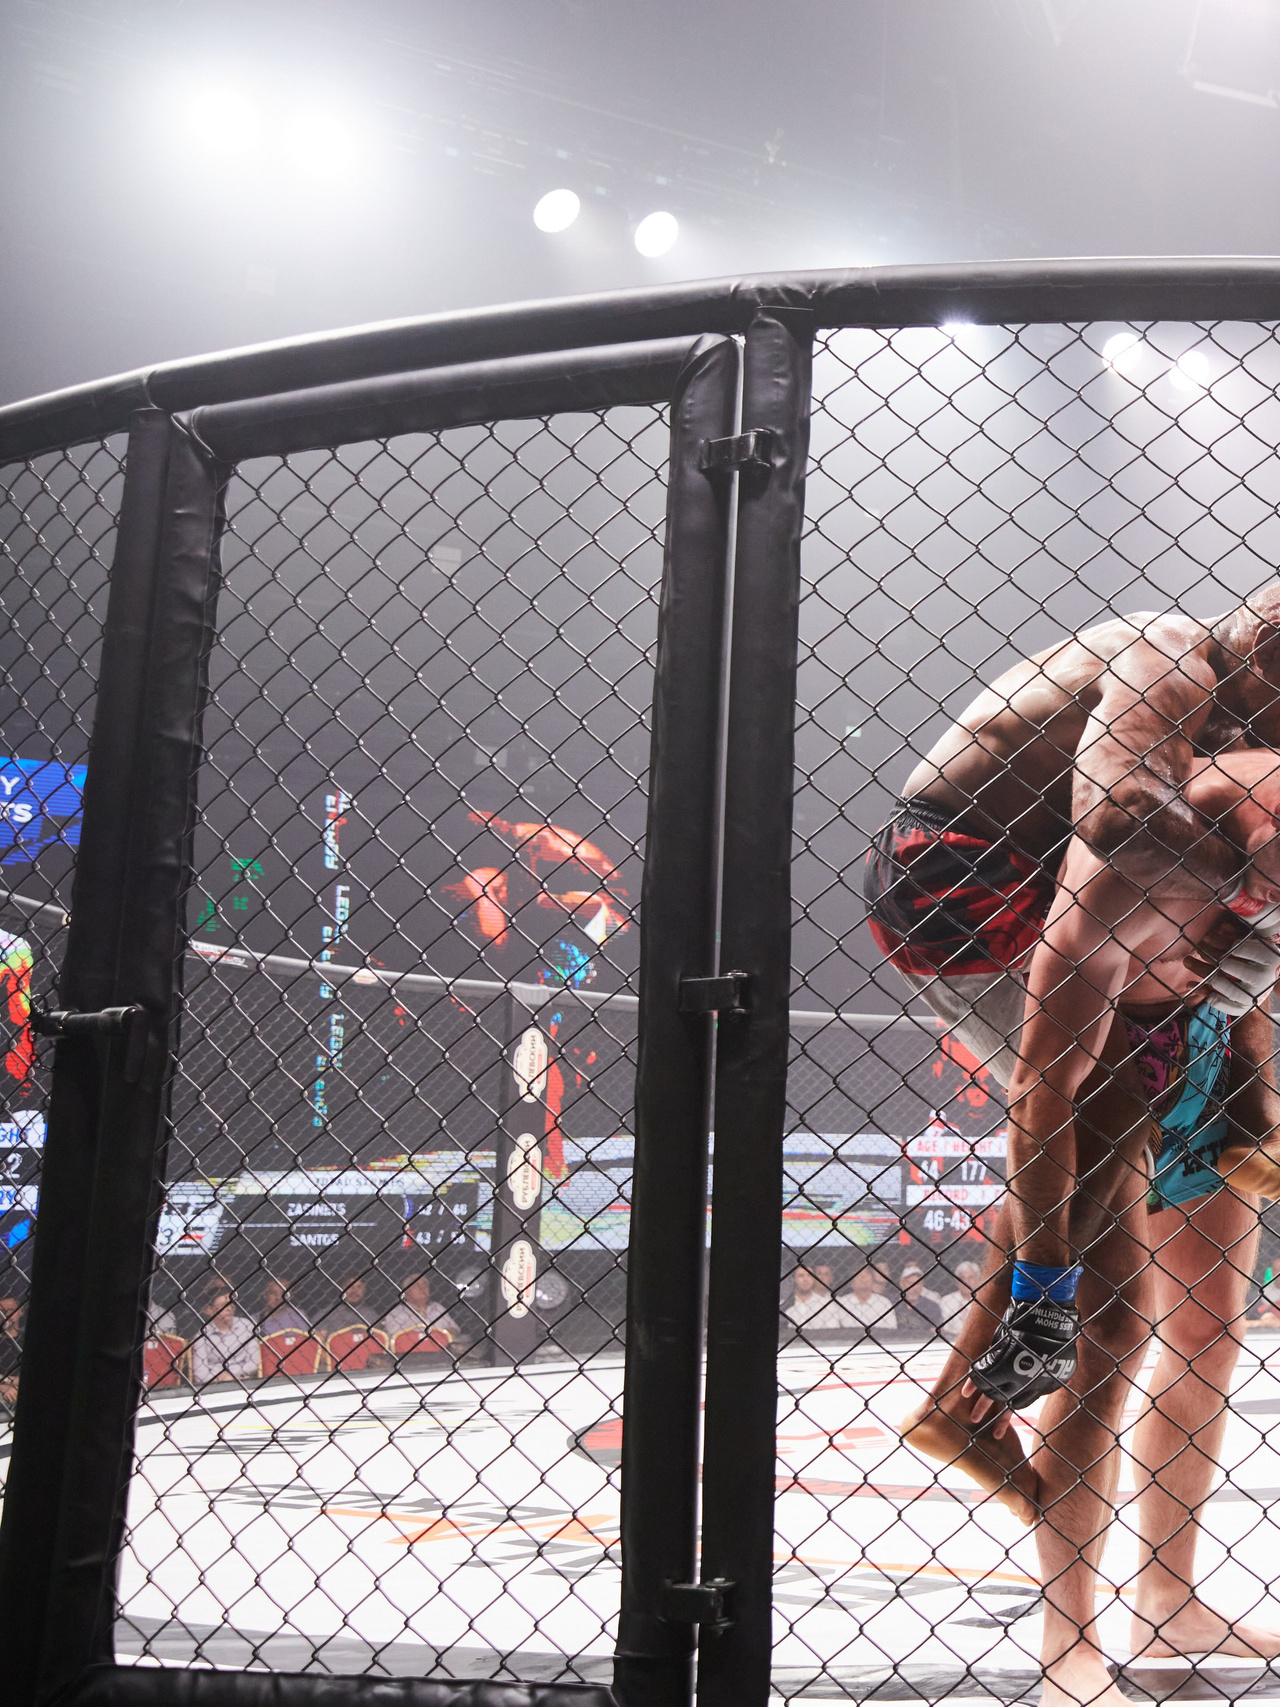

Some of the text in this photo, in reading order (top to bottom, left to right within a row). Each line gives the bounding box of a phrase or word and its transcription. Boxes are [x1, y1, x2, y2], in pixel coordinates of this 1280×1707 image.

[961, 1160, 988, 1181] 177
[1034, 1316, 1074, 1331] LESS SHOW
